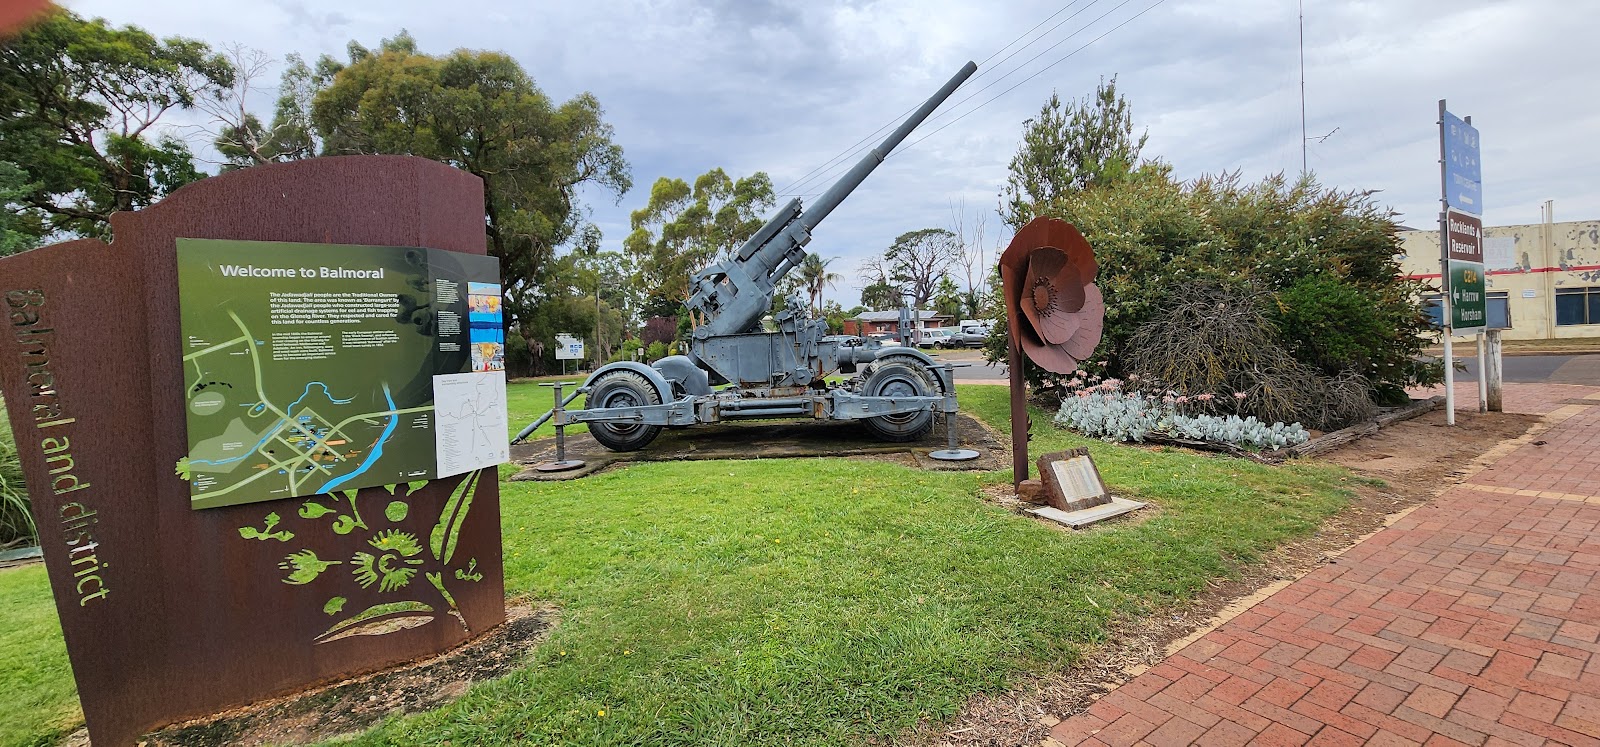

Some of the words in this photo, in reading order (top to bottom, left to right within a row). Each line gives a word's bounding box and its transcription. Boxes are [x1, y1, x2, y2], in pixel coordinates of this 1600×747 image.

[1450, 218, 1475, 237] Rocklands
[1451, 239, 1475, 255] Reservoir
[219, 264, 296, 278] Welcome
[299, 266, 316, 278] to
[319, 266, 384, 279] Balmoral
[1461, 289, 1479, 302] Harrow
[1460, 308, 1482, 321] Horsham
[5, 289, 76, 428] Balmoral
[41, 436, 91, 495] and
[59, 502, 110, 607] district
